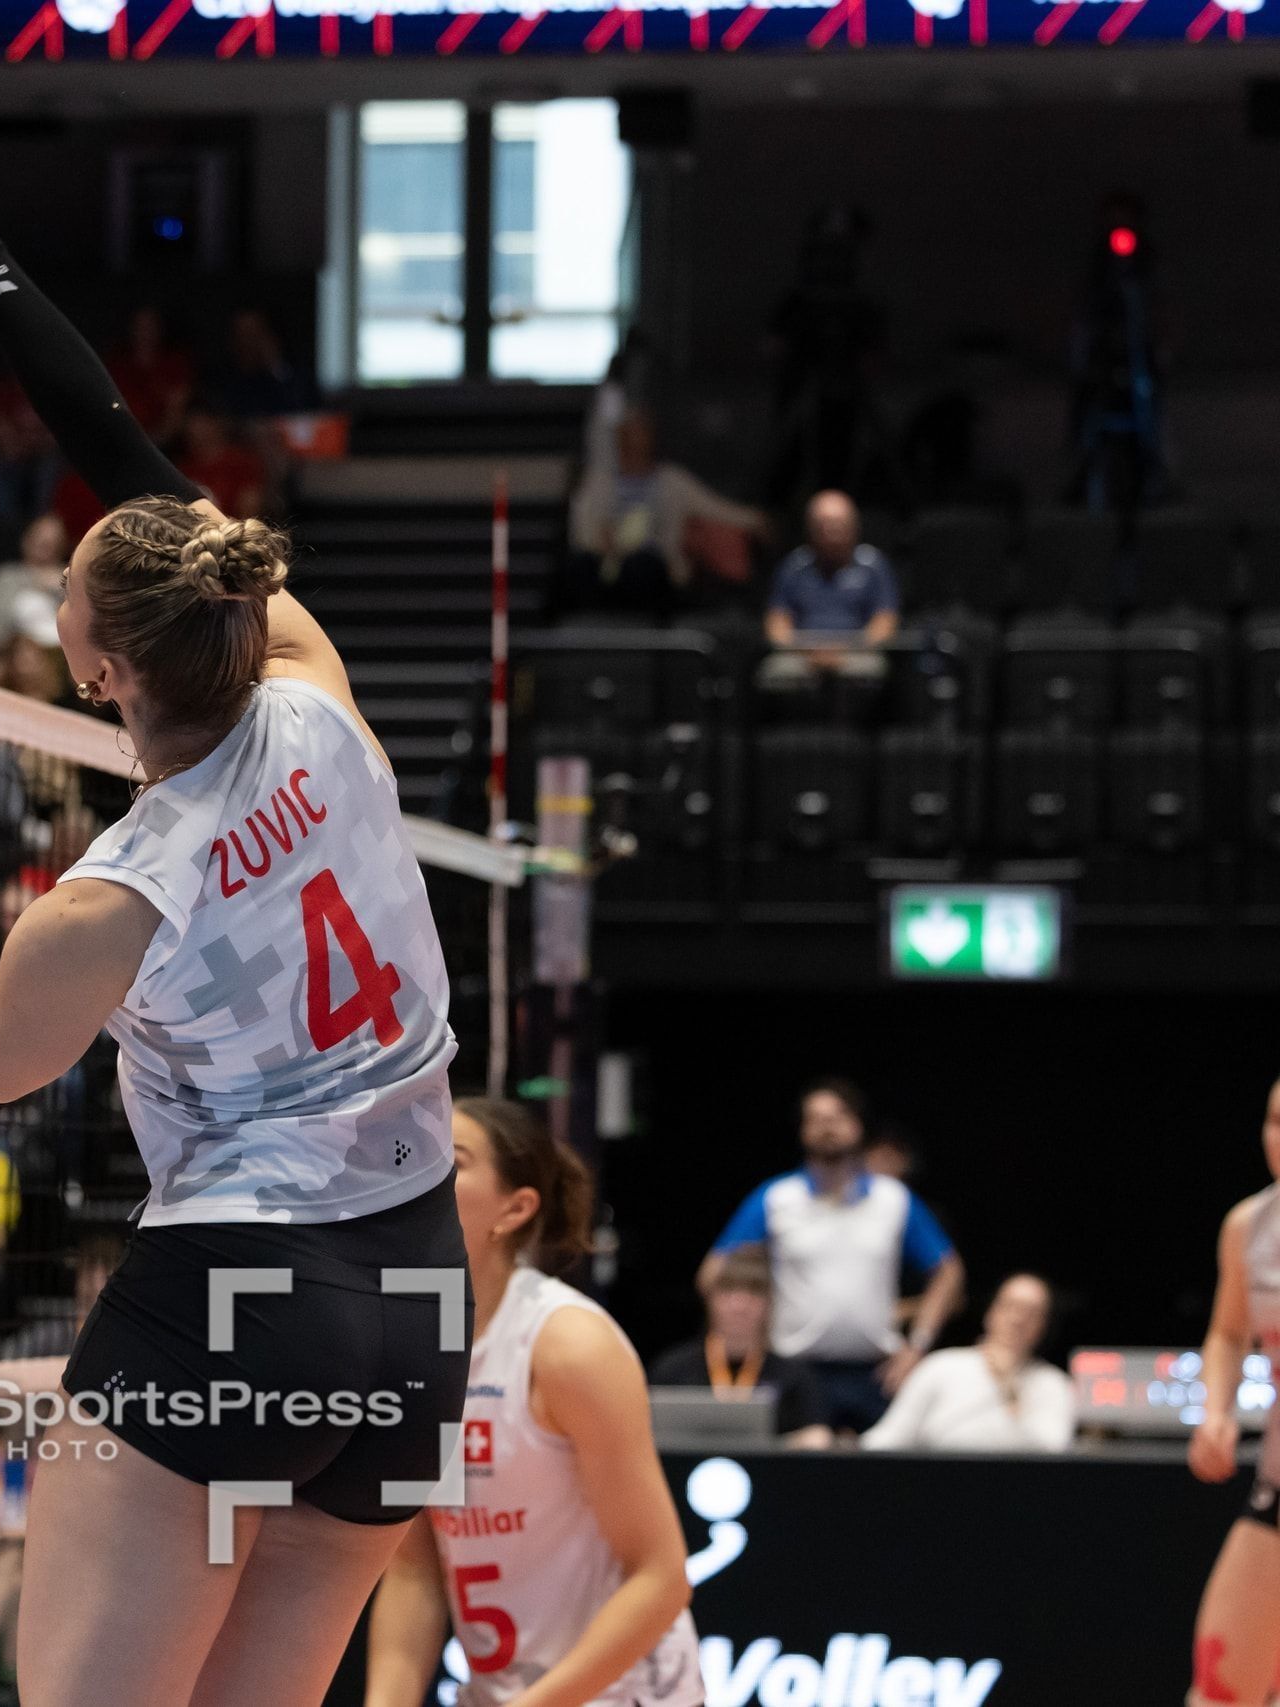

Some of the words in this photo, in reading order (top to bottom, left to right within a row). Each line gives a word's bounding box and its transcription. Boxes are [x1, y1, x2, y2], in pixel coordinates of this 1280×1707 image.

[209, 768, 327, 899] ZUVIC
[300, 867, 405, 1053] 4
[455, 1564, 517, 1674] 5
[699, 1632, 1003, 1707] Volley
